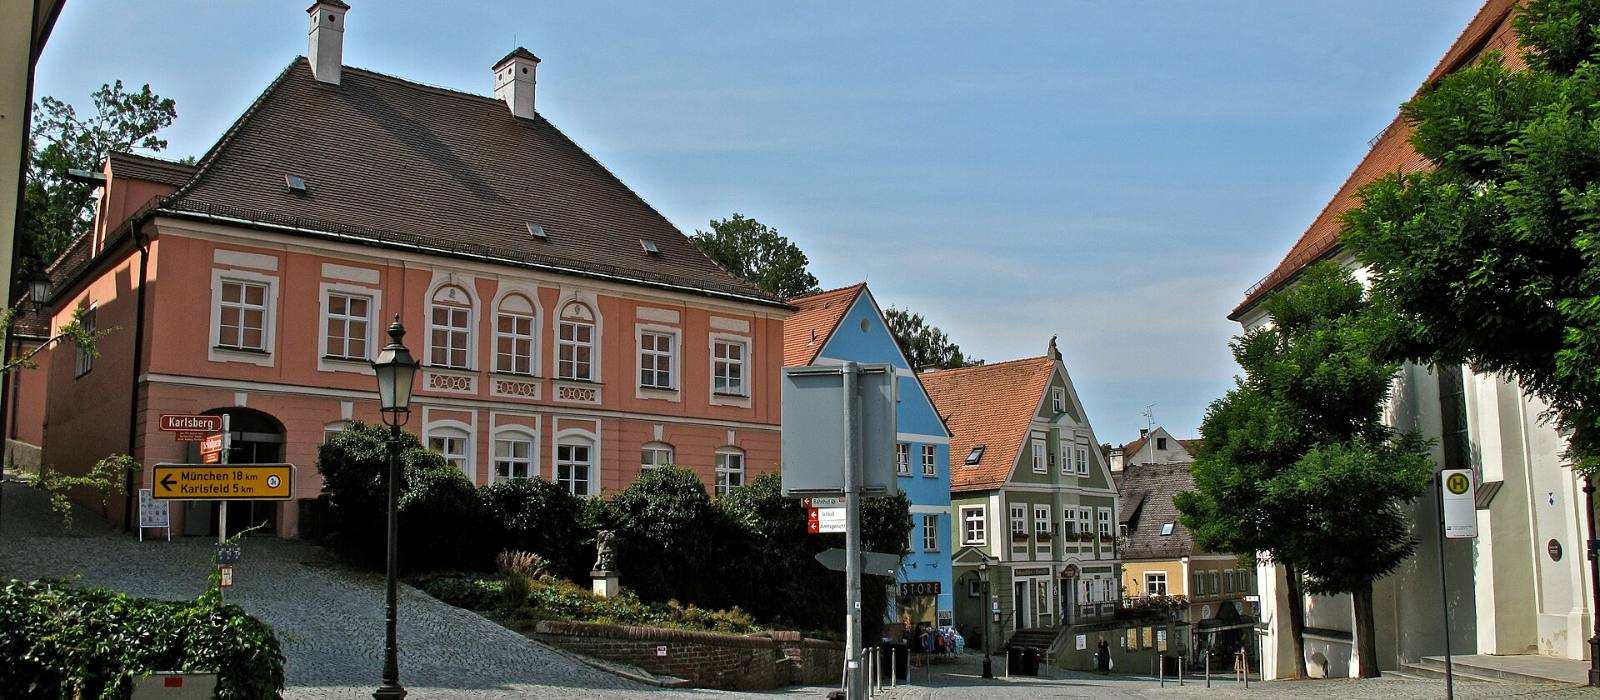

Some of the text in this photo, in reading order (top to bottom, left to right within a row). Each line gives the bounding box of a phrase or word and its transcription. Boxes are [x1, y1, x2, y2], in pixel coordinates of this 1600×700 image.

[169, 417, 213, 430] Karlsberg
[181, 471, 229, 481] München
[232, 471, 243, 480] 18
[180, 483, 254, 494] Karlsfeld 5 km
[1453, 478, 1463, 489] H
[903, 583, 938, 595] STORE
